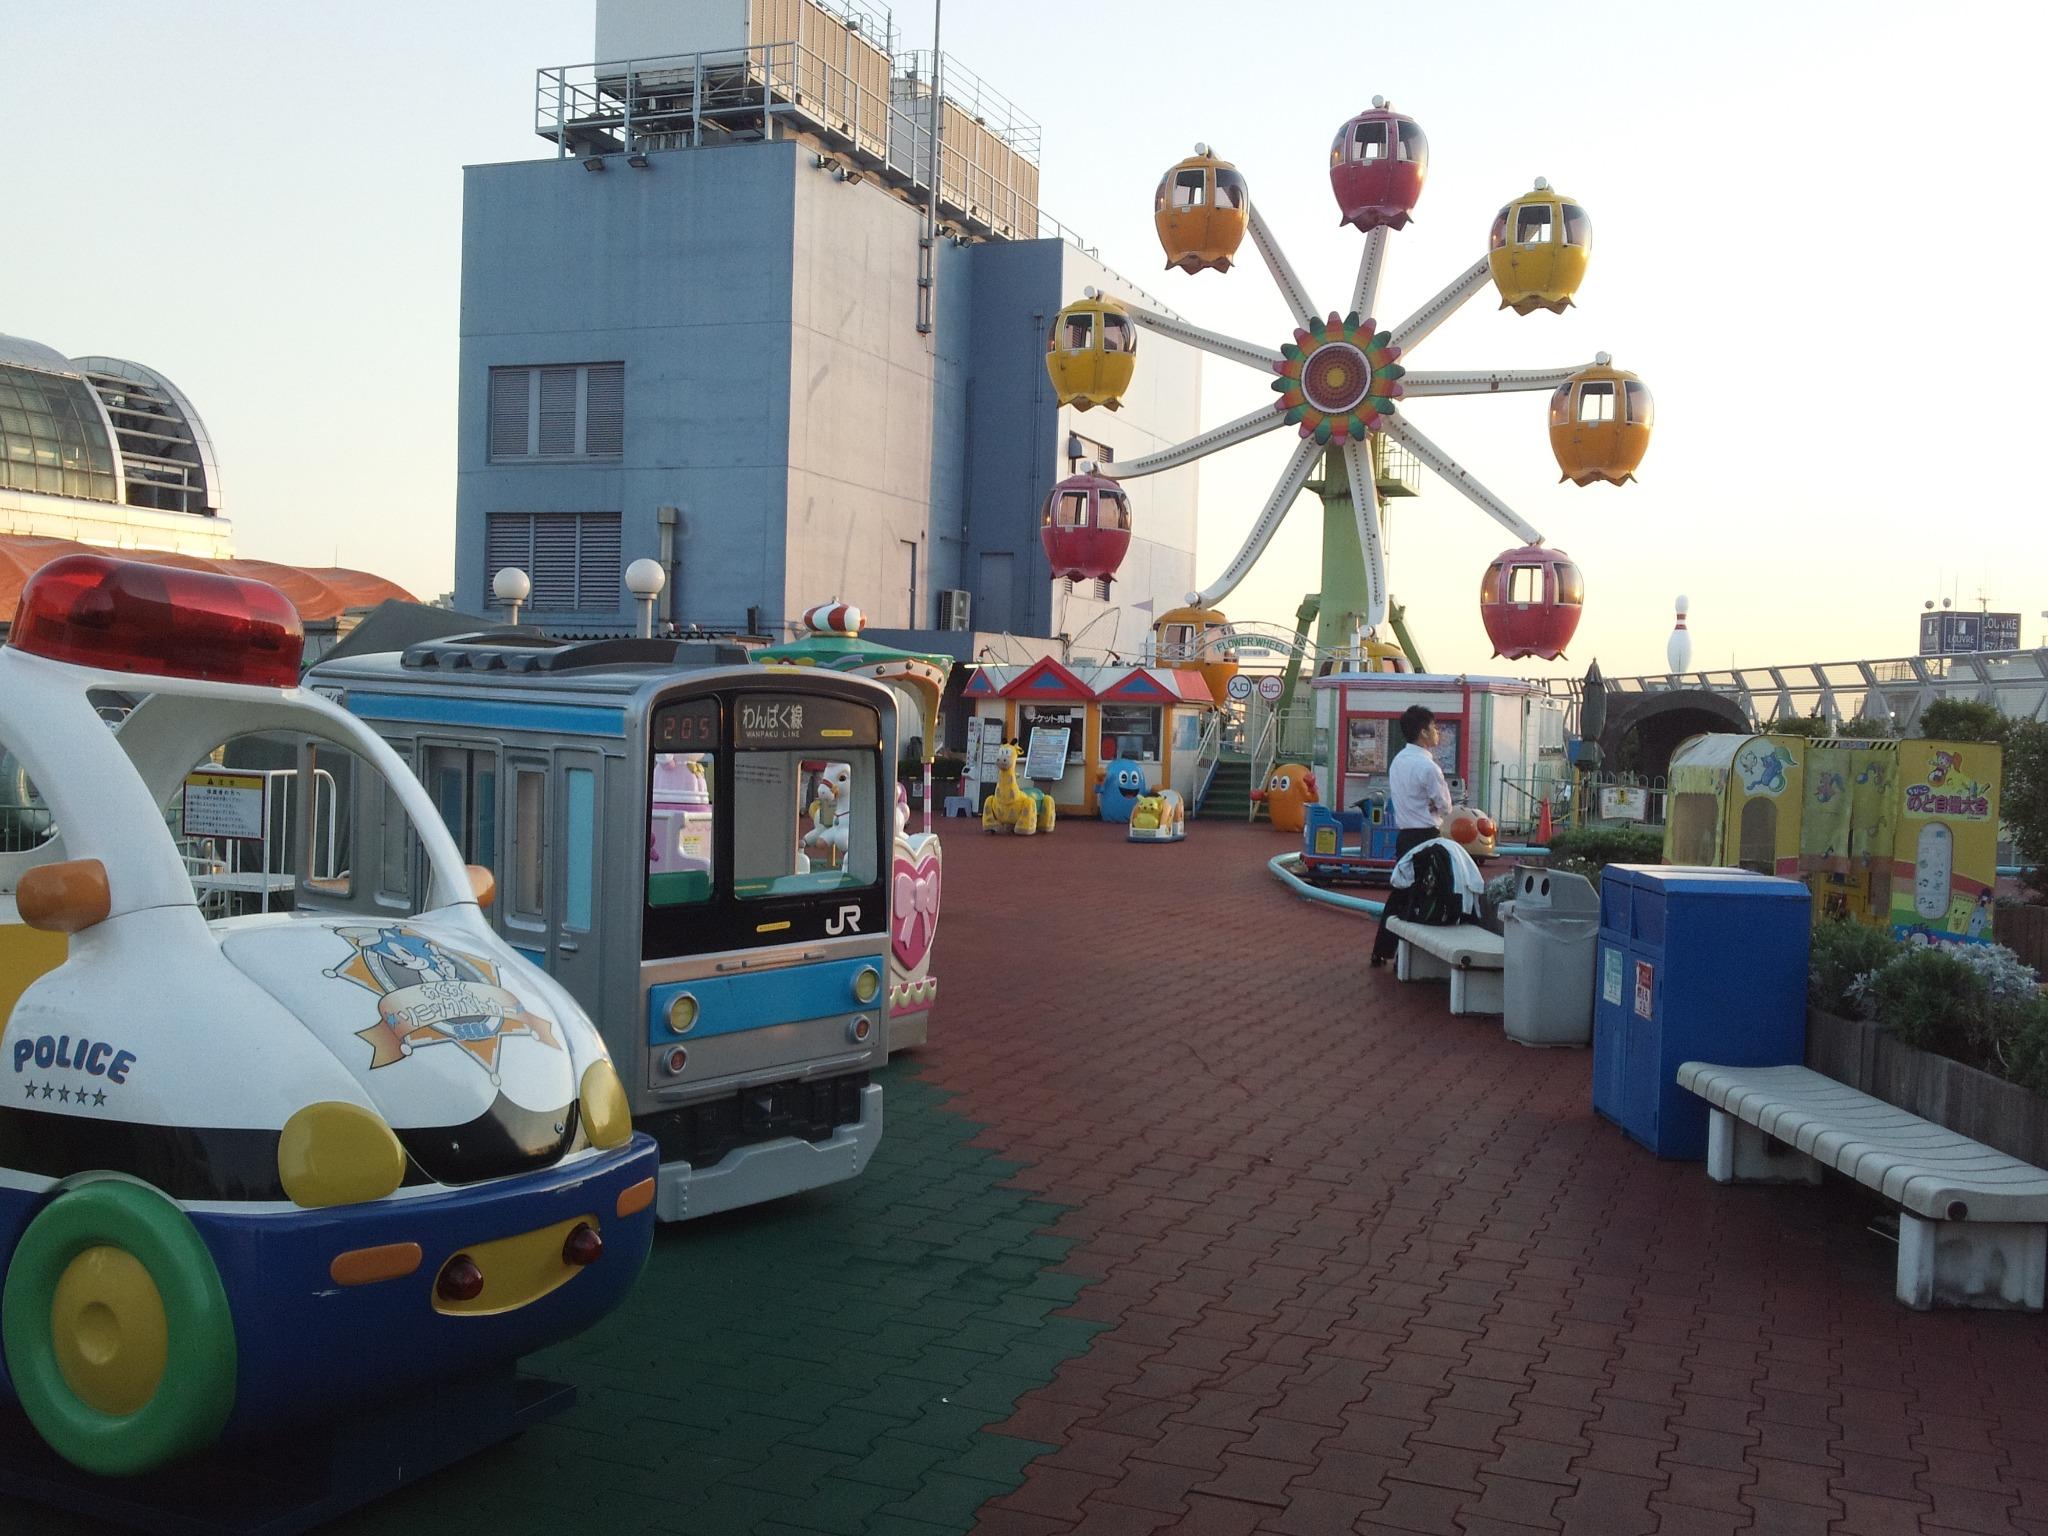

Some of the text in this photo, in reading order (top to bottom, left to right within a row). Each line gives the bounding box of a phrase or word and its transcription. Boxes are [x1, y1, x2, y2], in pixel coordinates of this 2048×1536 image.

[1216, 636, 1256, 653] FLOWER
[1255, 638, 1286, 653] WHEEL
[1948, 634, 1975, 644] LOUVRE
[1231, 682, 1249, 692] 入口
[1261, 682, 1280, 693] 出口
[742, 703, 803, 729] わんぱく線
[664, 717, 709, 739] 205
[745, 730, 800, 738] WANPAKU LINE
[1907, 795, 1988, 816] のど自慢大会
[825, 905, 861, 935] JR
[420, 982, 473, 1000] わくわく
[453, 1022, 491, 1040] SEGA
[14, 1035, 137, 1085] POLICE
